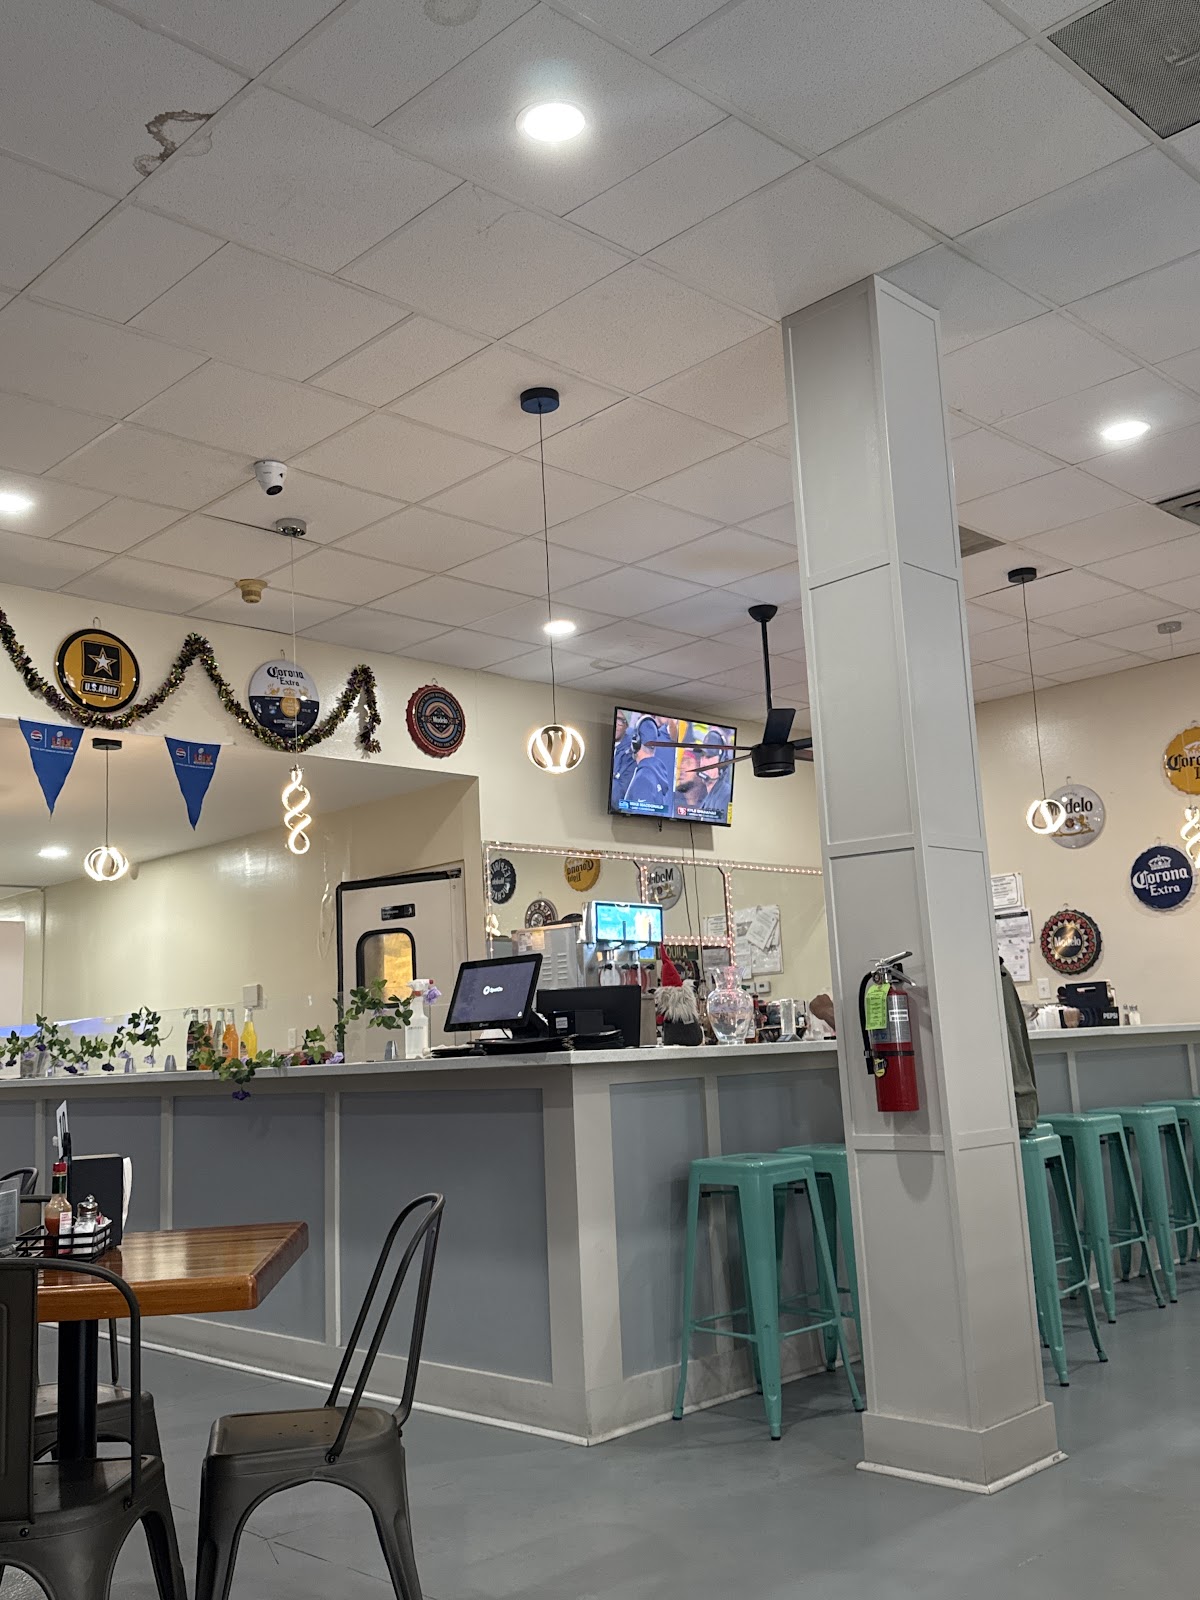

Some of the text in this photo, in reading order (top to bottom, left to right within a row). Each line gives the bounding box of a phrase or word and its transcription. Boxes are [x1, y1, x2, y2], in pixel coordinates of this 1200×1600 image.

[266, 666, 305, 679] Corona
[280, 677, 300, 686] Extra
[1132, 868, 1190, 890] Corona
[1150, 884, 1181, 896] Extra
[1054, 936, 1082, 947] Modelo
